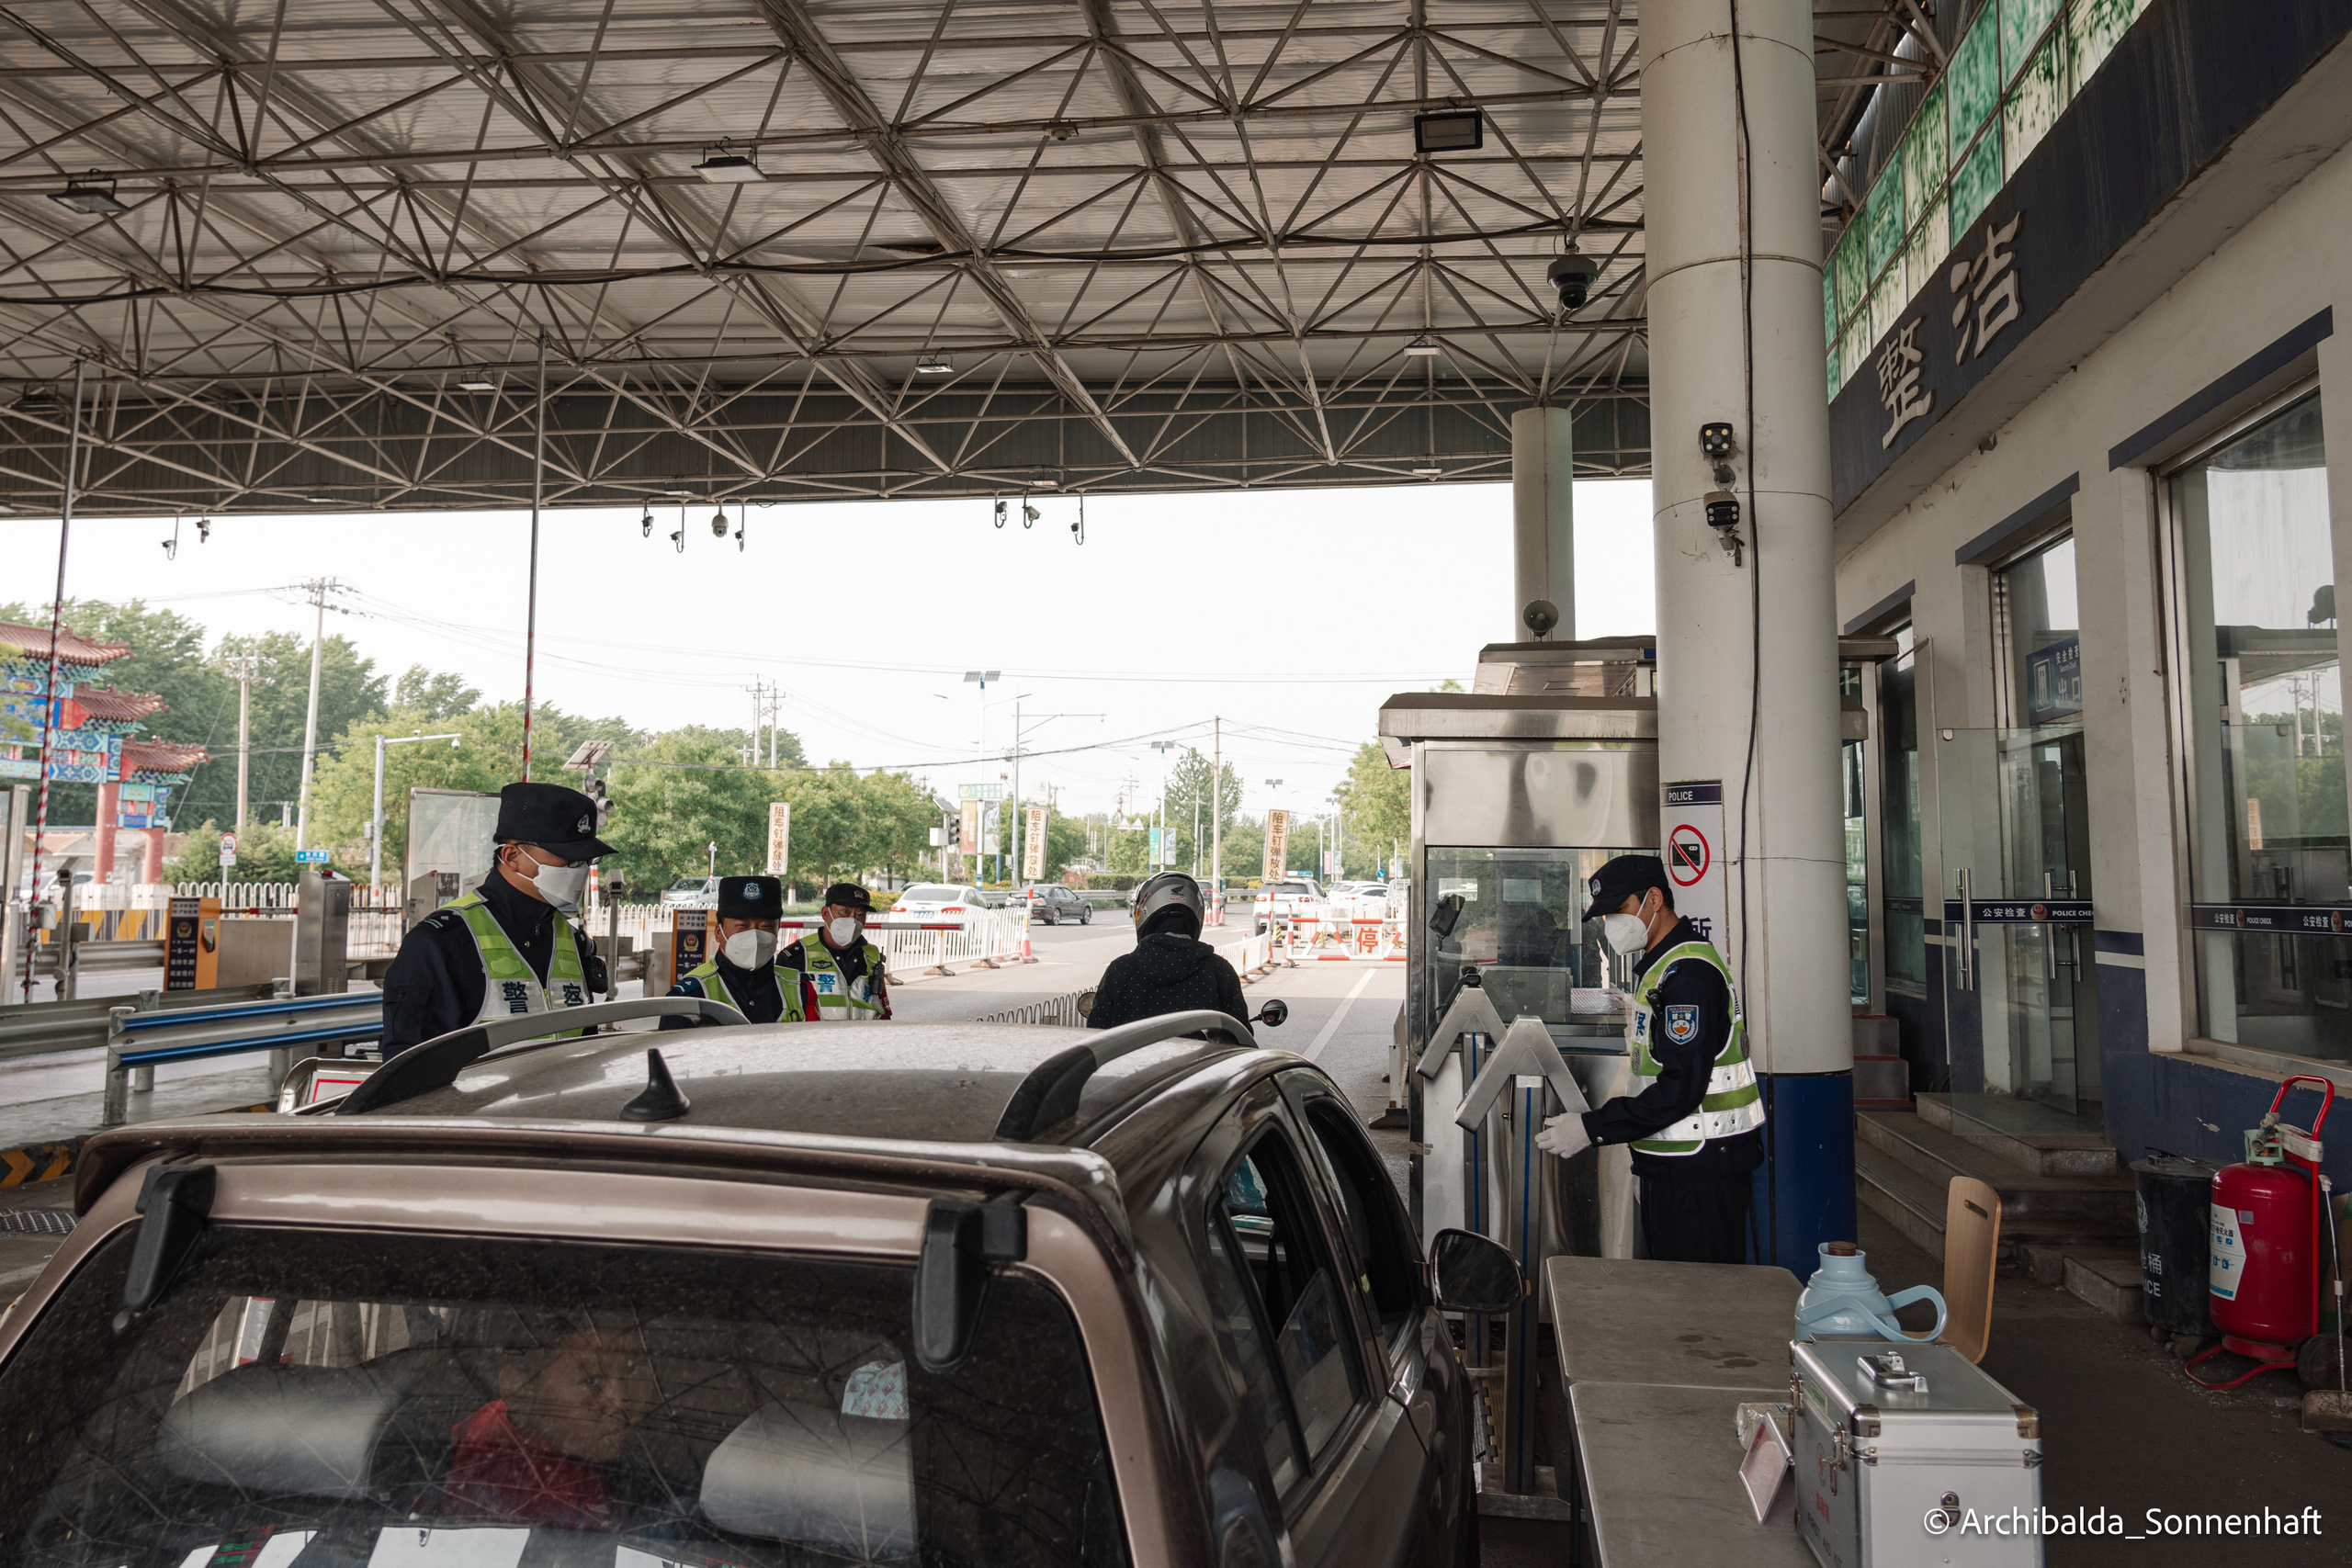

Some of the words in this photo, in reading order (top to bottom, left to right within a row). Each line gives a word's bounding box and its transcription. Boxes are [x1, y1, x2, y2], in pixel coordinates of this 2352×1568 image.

[2058, 676, 2080, 703] 出口
[1668, 791, 1693, 802] POLICE
[1983, 908, 2026, 918] 公安检查
[2214, 913, 2235, 924] 公安检查
[2302, 915, 2329, 928] 公安检查
[1356, 927, 1378, 953] 停
[818, 974, 835, 993] 警
[502, 981, 528, 1014] 警
[562, 980, 584, 1007] 察
